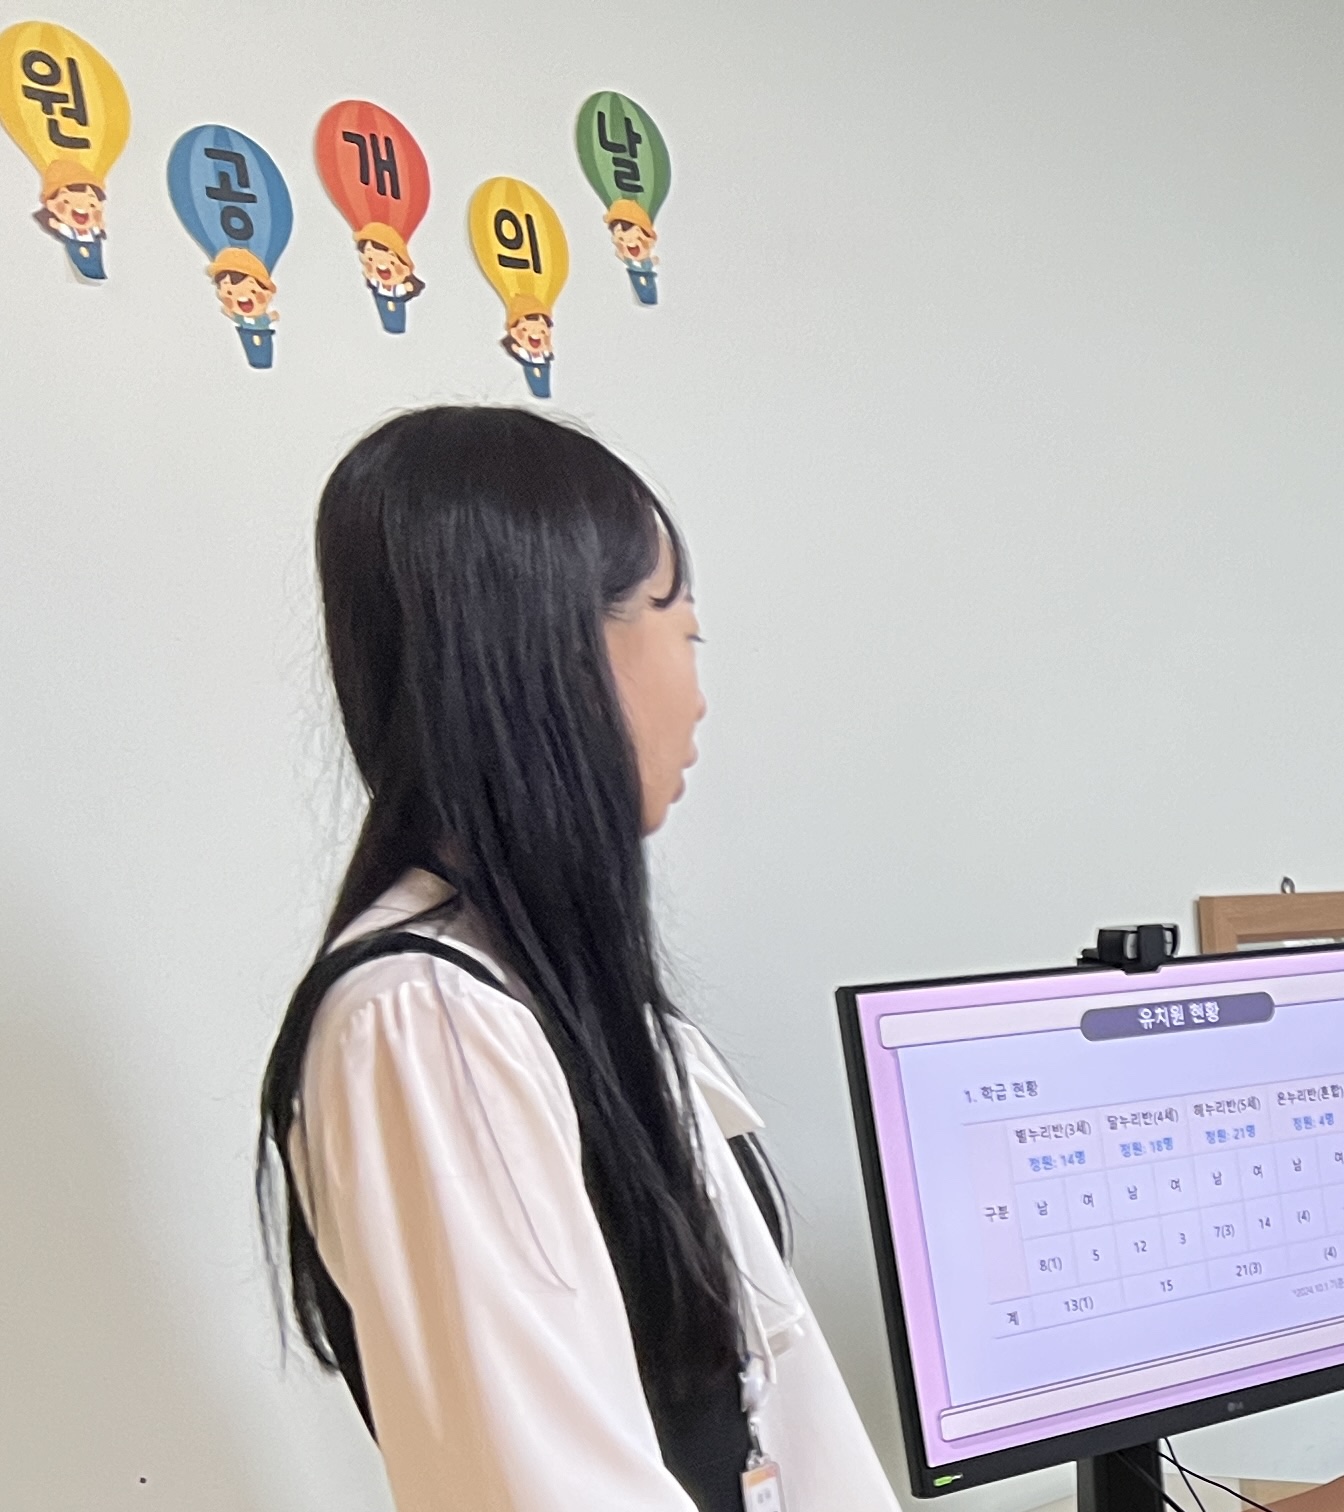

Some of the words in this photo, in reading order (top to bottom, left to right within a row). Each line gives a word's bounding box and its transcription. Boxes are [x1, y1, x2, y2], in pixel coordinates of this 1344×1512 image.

[21, 49, 92, 149] 원
[203, 147, 259, 241] 공
[342, 130, 401, 200] 개
[493, 208, 543, 275] 의
[597, 110, 645, 194] 날
[1138, 1003, 1186, 1030] 유치원
[1188, 1000, 1221, 1024] 현황
[963, 1089, 978, 1104] 1.
[980, 1083, 1008, 1102] 학급
[1012, 1079, 1039, 1098] 현황
[1291, 1157, 1303, 1173] 남
[1333, 1150, 1344, 1166] 여
[1211, 1170, 1223, 1187] 남
[1252, 1163, 1264, 1179] 여
[1126, 1184, 1139, 1201] 남
[1170, 1177, 1182, 1193] 여
[1082, 1192, 1095, 1208] 여
[984, 1205, 1010, 1223] 구분
[1036, 1200, 1049, 1217] 남
[1258, 1216, 1272, 1230] 14
[1296, 1209, 1312, 1225] (4)
[1178, 1232, 1187, 1246] 3
[1212, 1223, 1236, 1240] 7(3)
[1133, 1239, 1148, 1254] 12
[1322, 1245, 1338, 1261] (4)
[1091, 1248, 1101, 1262] 5
[1038, 1255, 1064, 1273] 8(1)
[1235, 1261, 1263, 1278] 21(3)
[1159, 1278, 1175, 1293] 15
[1063, 1295, 1095, 1313] 13(1)
